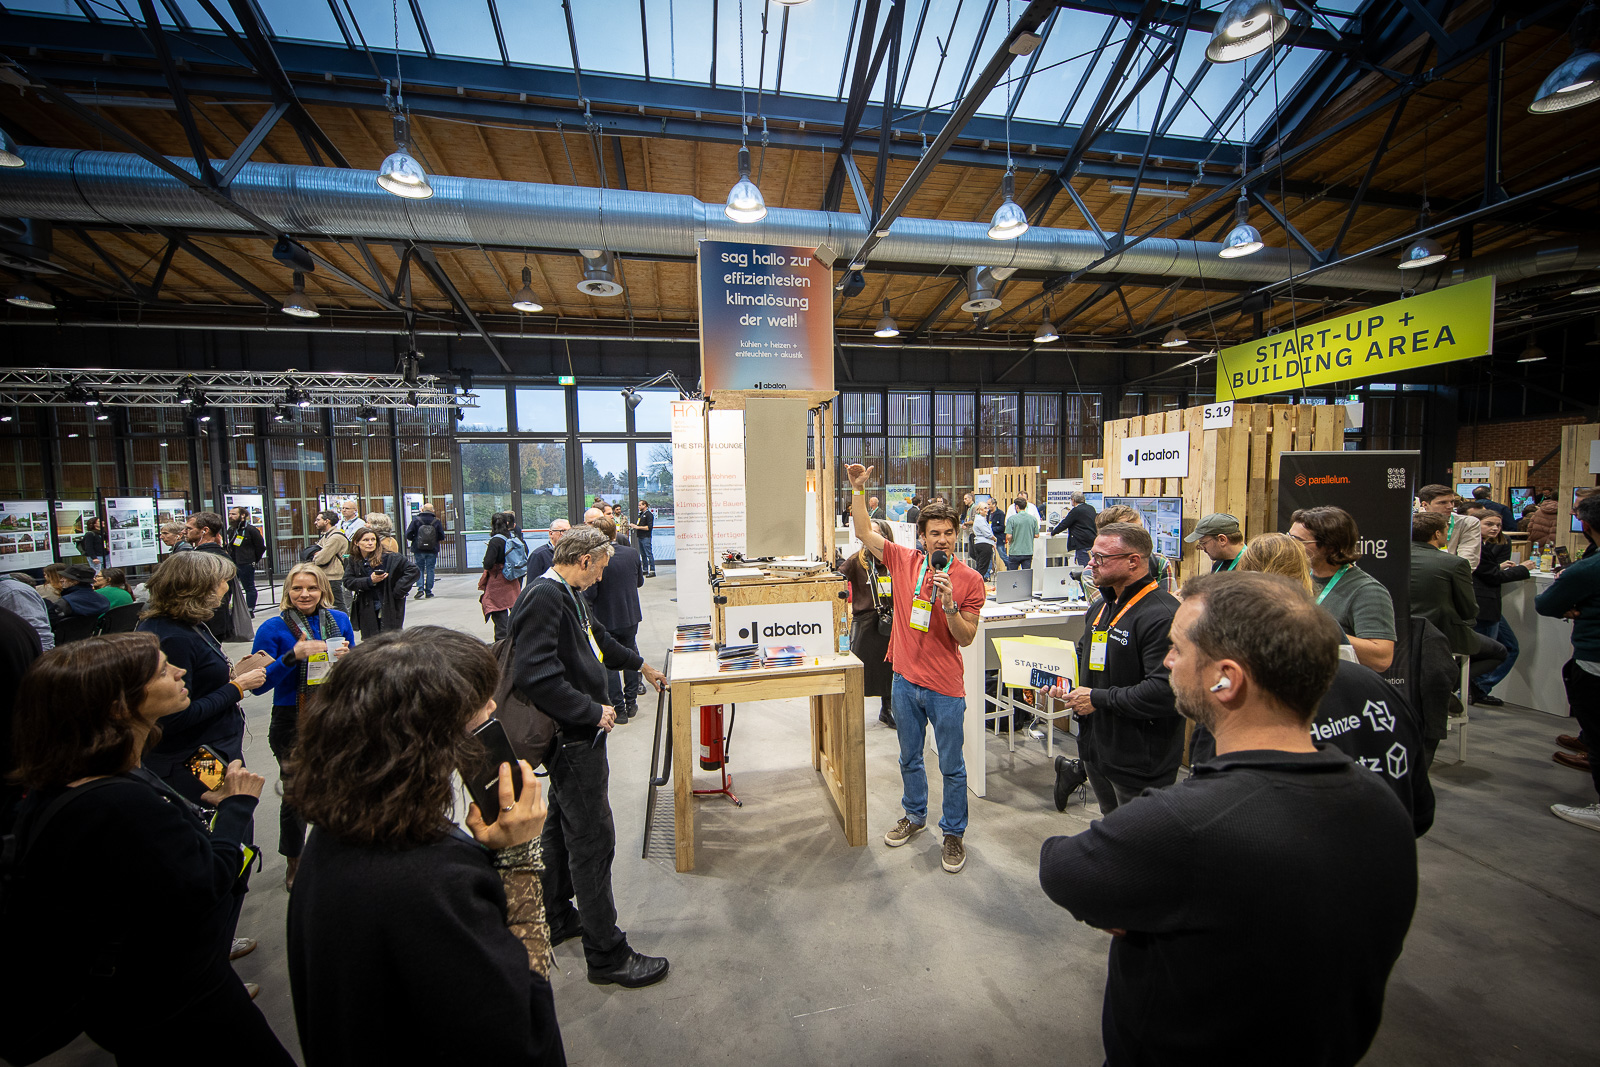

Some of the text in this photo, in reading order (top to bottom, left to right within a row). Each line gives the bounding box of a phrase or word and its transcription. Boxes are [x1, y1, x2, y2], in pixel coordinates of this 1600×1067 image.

[721, 249, 812, 267] sag hallo zur
[723, 272, 811, 288] effizientesten
[726, 290, 809, 311] klimalösung
[739, 313, 798, 328] der welt!
[740, 340, 762, 348] kühlen
[770, 341, 791, 349] heizen
[1255, 312, 1415, 363] START-UP +
[735, 350, 772, 358] entfeuchten
[780, 351, 803, 359] akustik
[1232, 325, 1457, 389] BUILDING AREA
[1204, 405, 1231, 419] S.19
[1141, 449, 1180, 461] abaton
[676, 501, 722, 509] klimapotiv
[706, 531, 745, 539] rfertigen
[763, 620, 822, 638] abaton
[1014, 658, 1061, 673] START-UP
[1385, 677, 1405, 685] ation
[1355, 755, 1383, 772] tz
